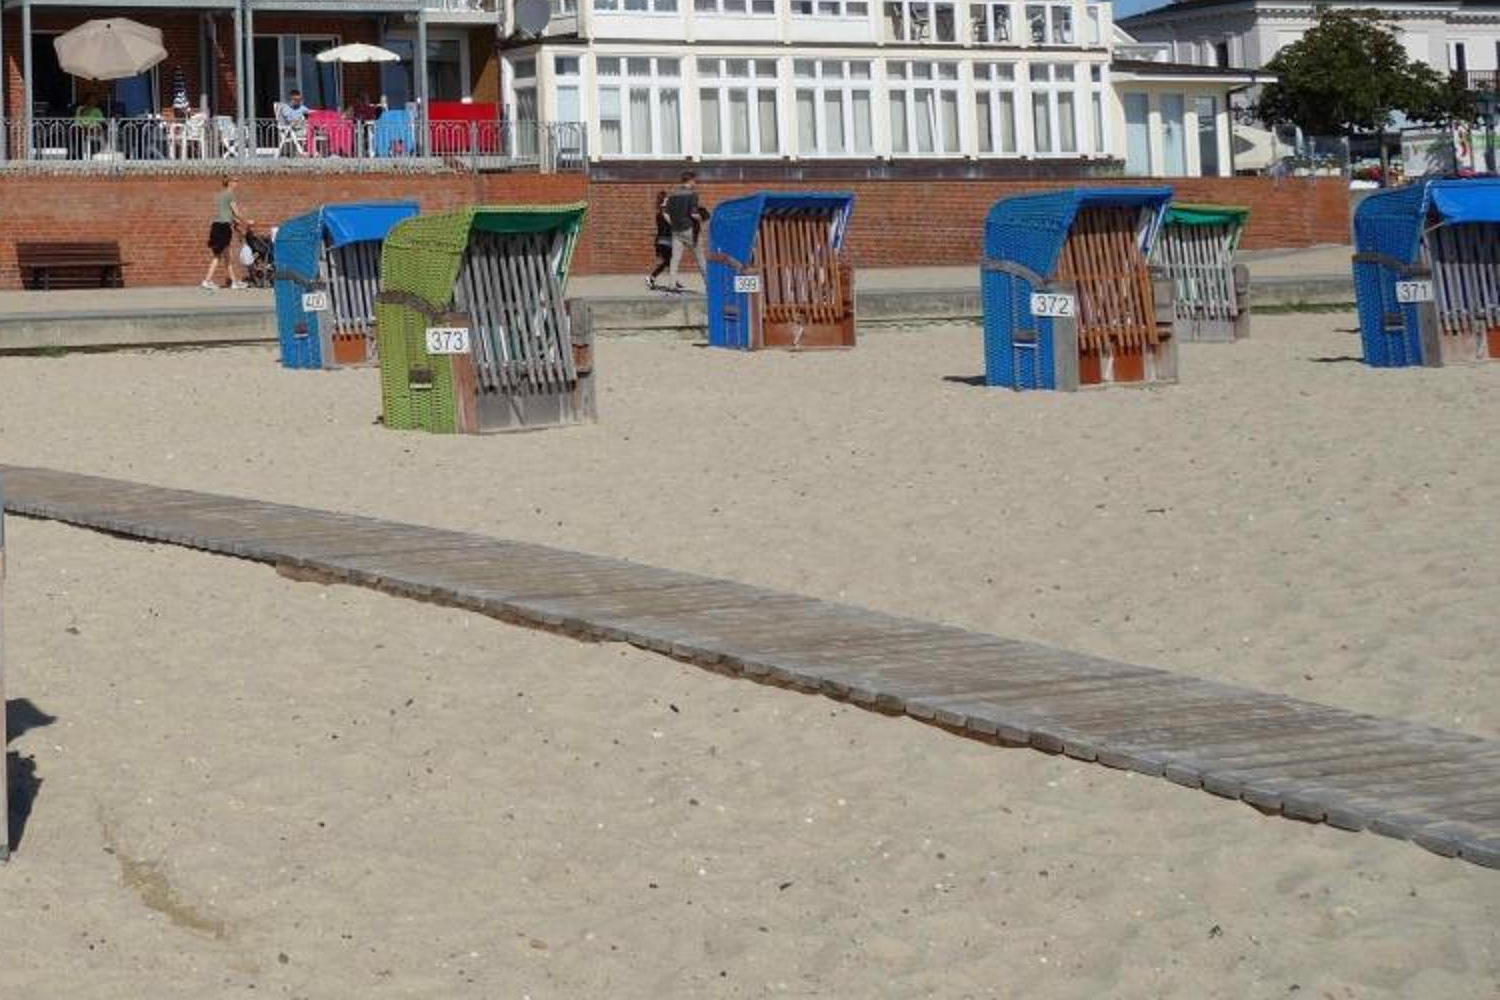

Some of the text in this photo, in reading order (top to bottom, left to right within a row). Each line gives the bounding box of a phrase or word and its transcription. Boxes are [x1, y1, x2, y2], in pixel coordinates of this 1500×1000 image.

[1402, 284, 1428, 300] 371
[1036, 295, 1069, 313] 372
[431, 331, 464, 351] 373
